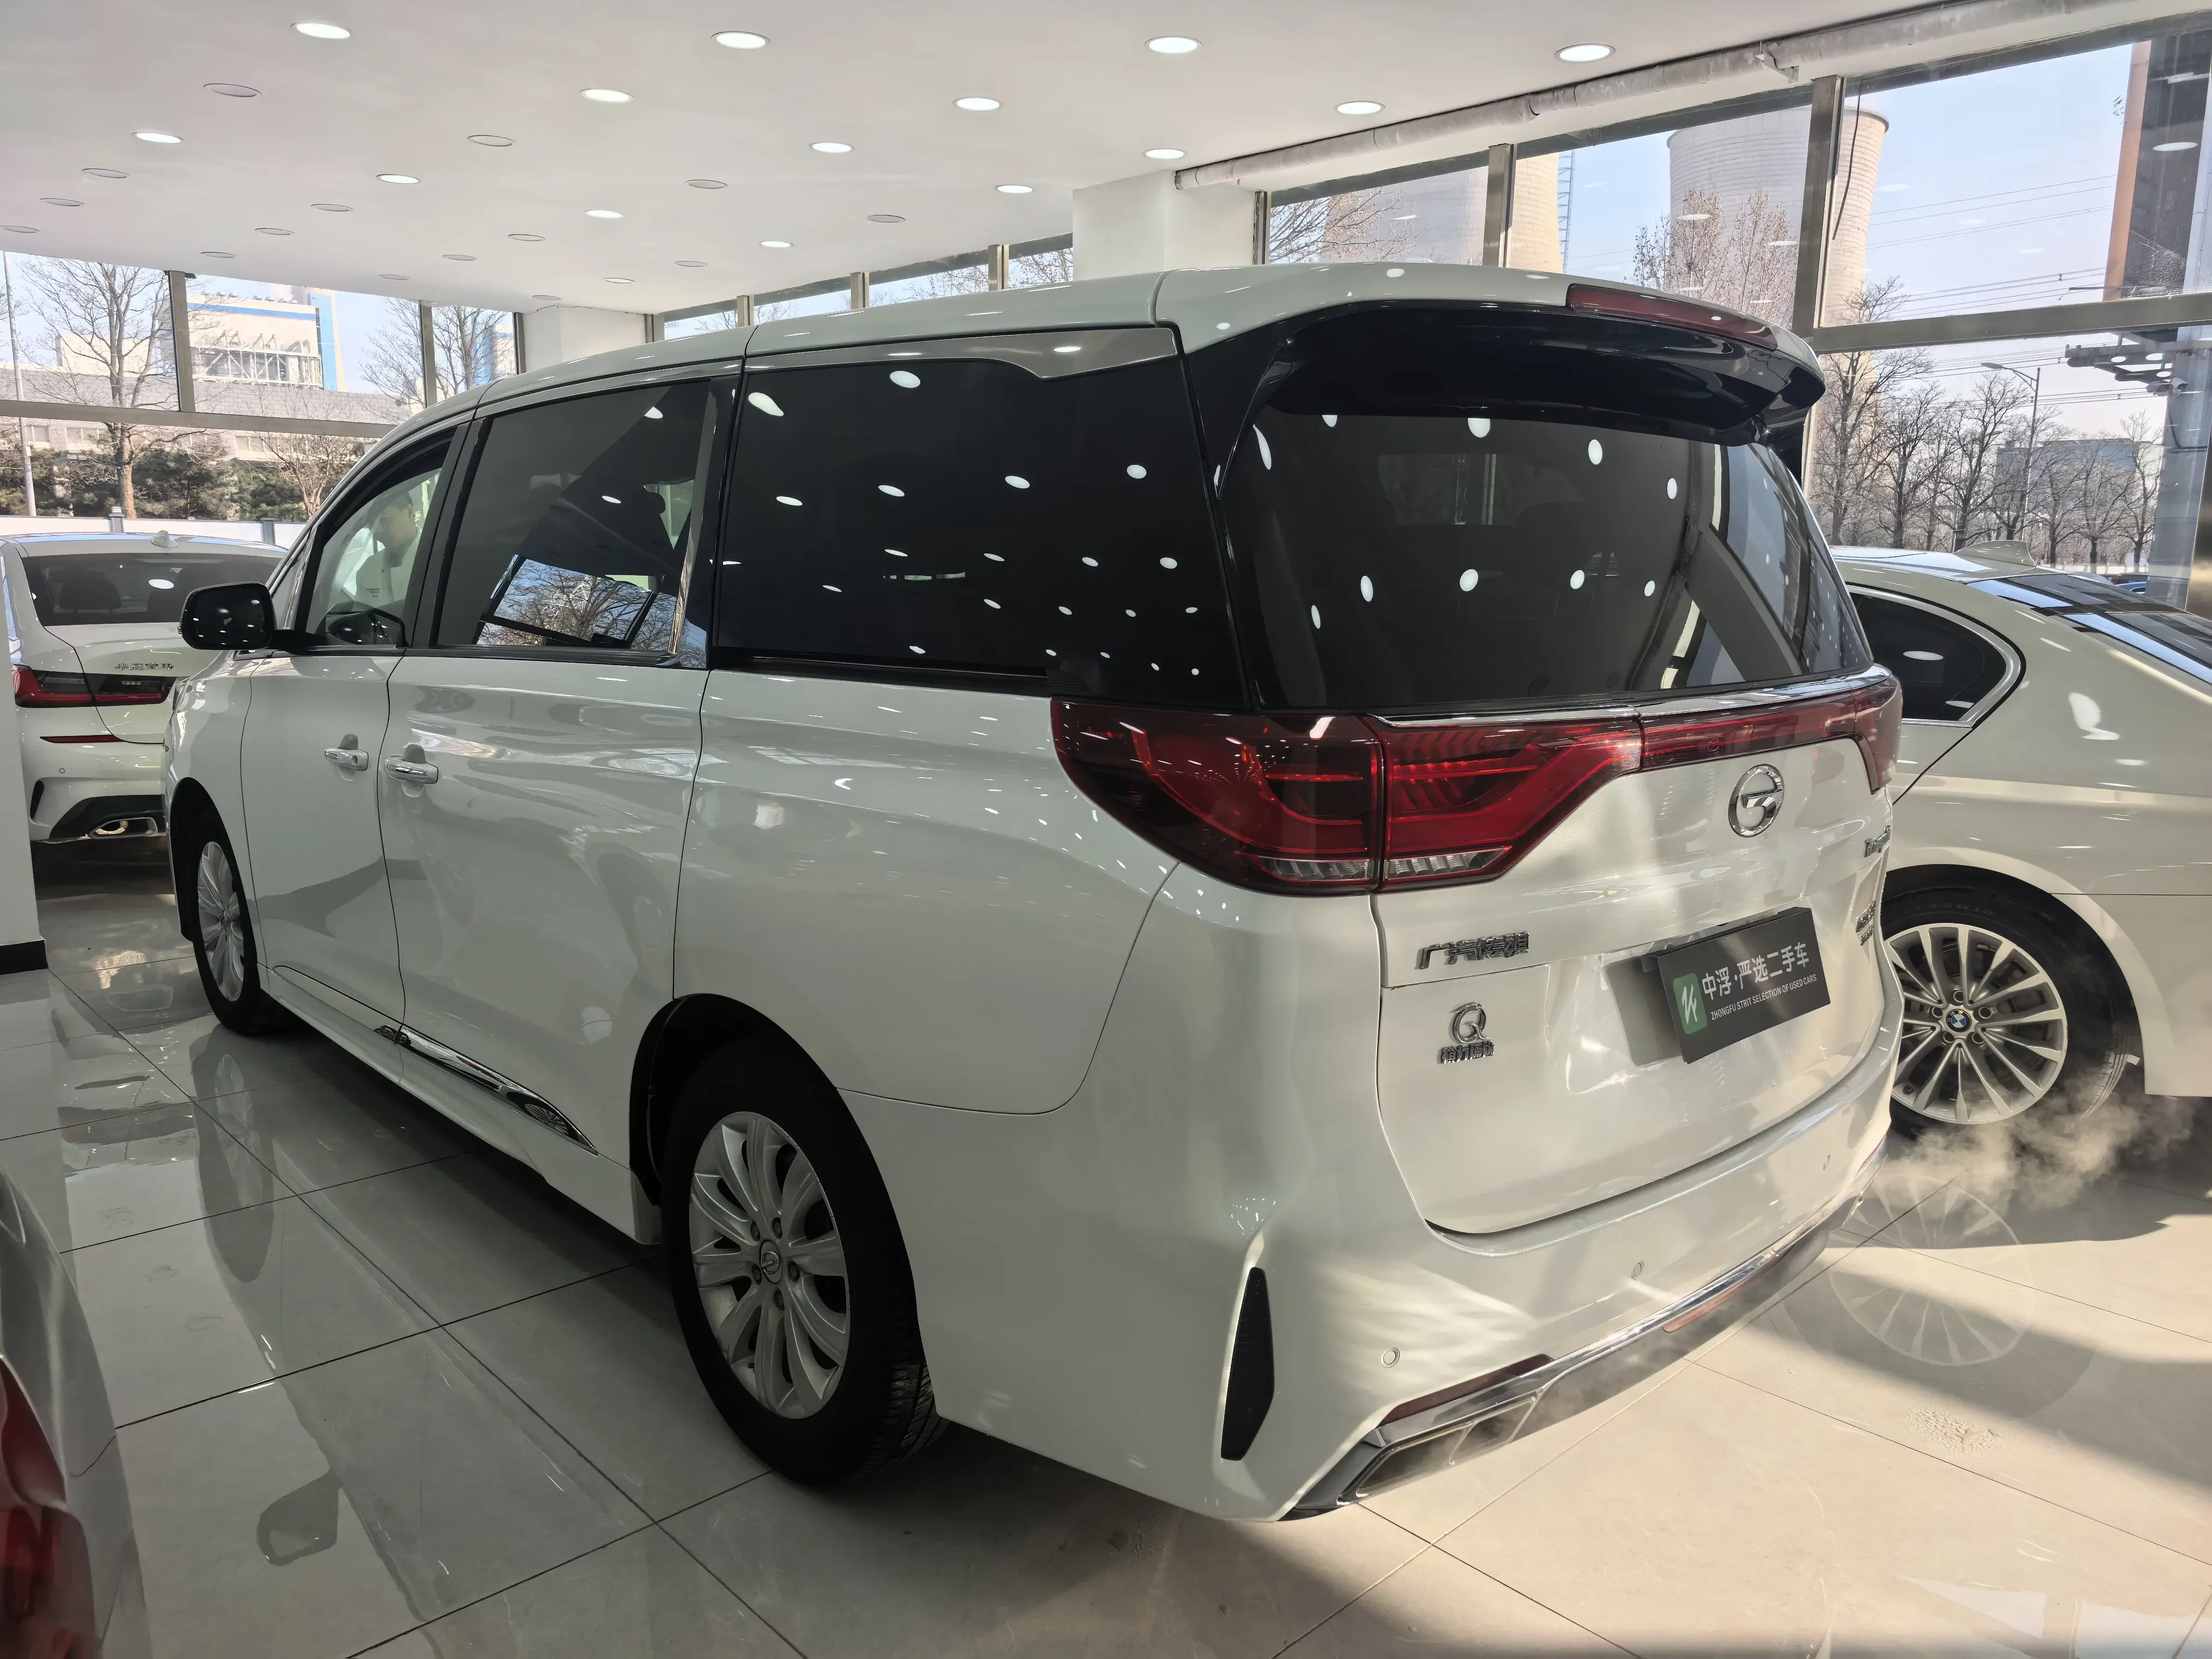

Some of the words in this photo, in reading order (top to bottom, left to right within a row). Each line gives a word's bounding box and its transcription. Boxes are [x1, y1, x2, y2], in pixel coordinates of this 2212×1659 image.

[1710, 1003, 1737, 1020] ZHONGFU
[1736, 997, 1752, 1010] STRIT
[1752, 987, 1782, 1004] SELECTION
[1782, 984, 1789, 993] OF
[1789, 979, 1803, 990] USED
[1803, 974, 1817, 985] CARS
